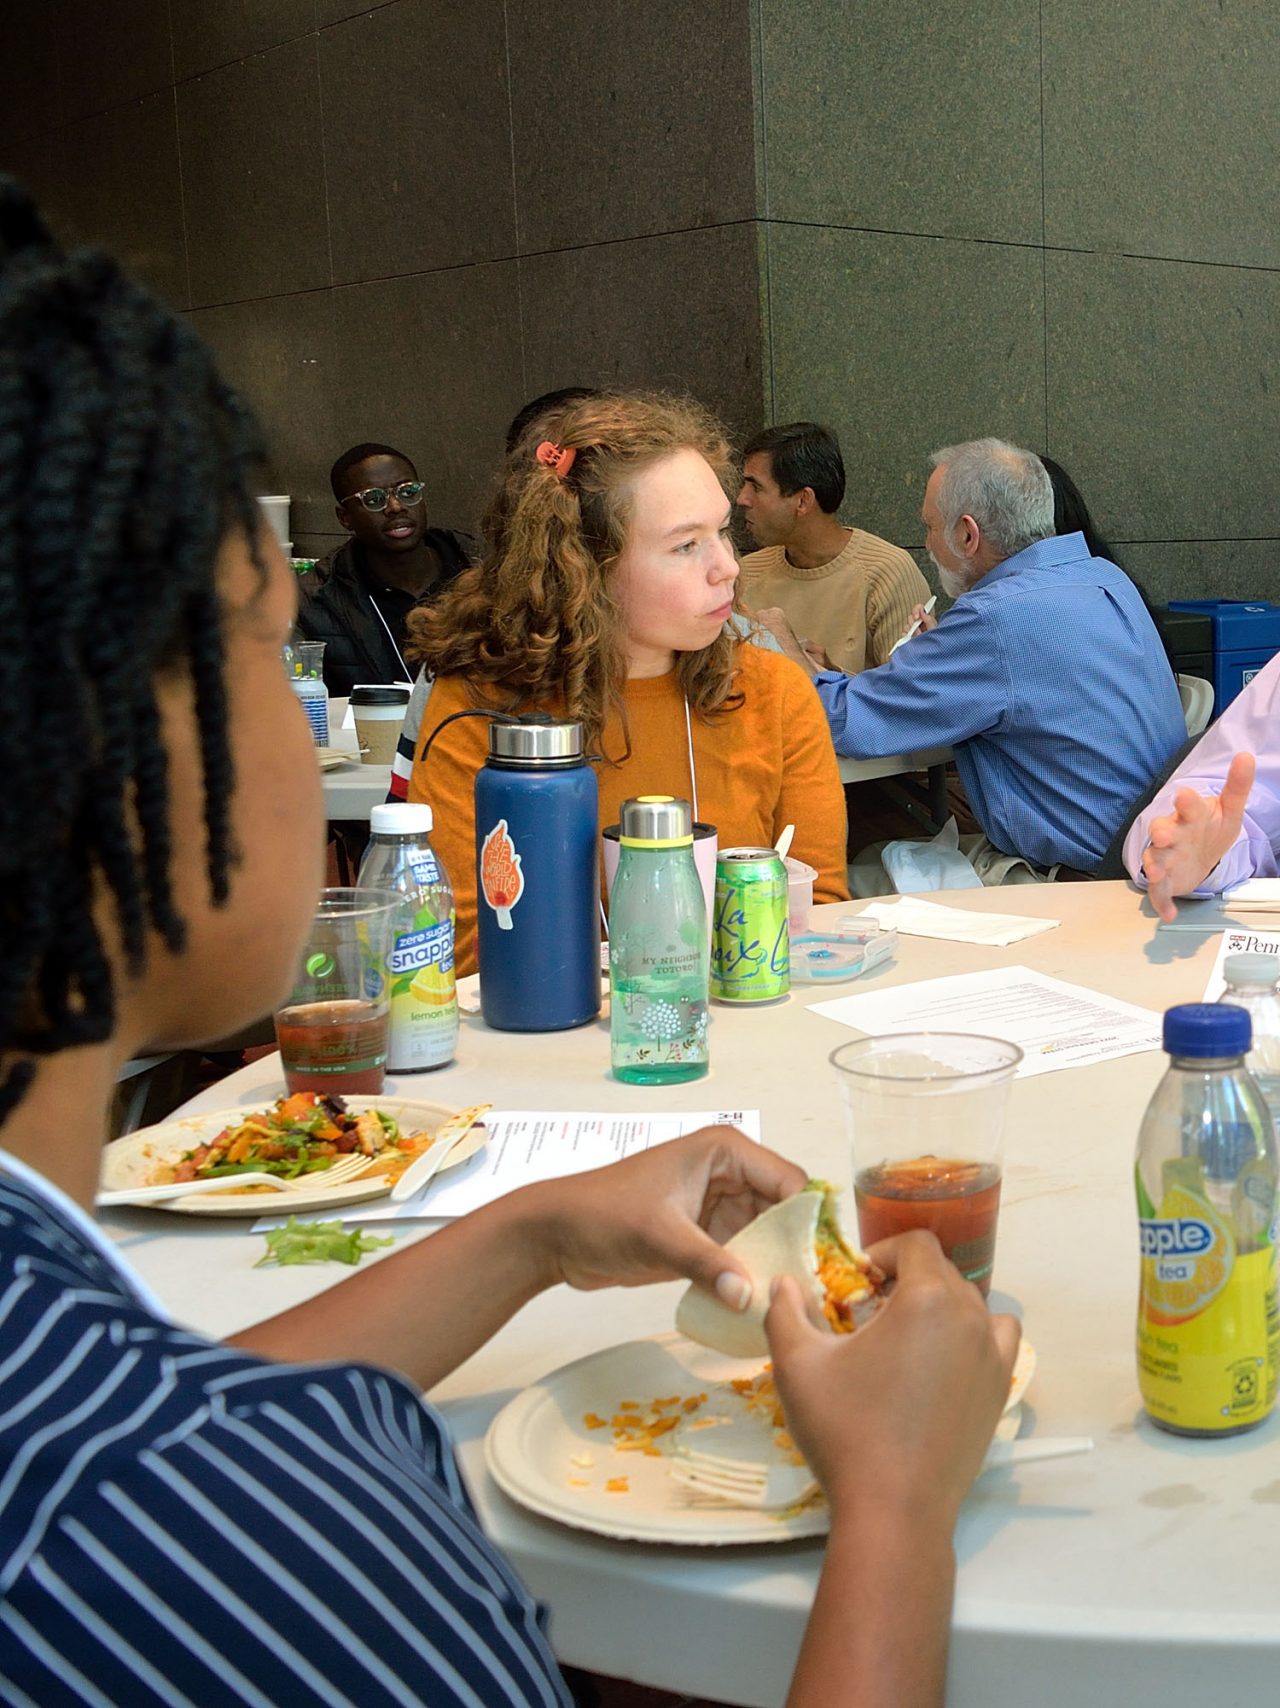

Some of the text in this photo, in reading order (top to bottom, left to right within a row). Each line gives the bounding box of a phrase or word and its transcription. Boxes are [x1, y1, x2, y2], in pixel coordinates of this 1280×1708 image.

[399, 932, 425, 947] zero
[392, 933, 455, 969] snappl
[655, 964, 694, 974] TOTORO
[411, 1009, 444, 1021] lemon
[1159, 1264, 1187, 1279] tea
